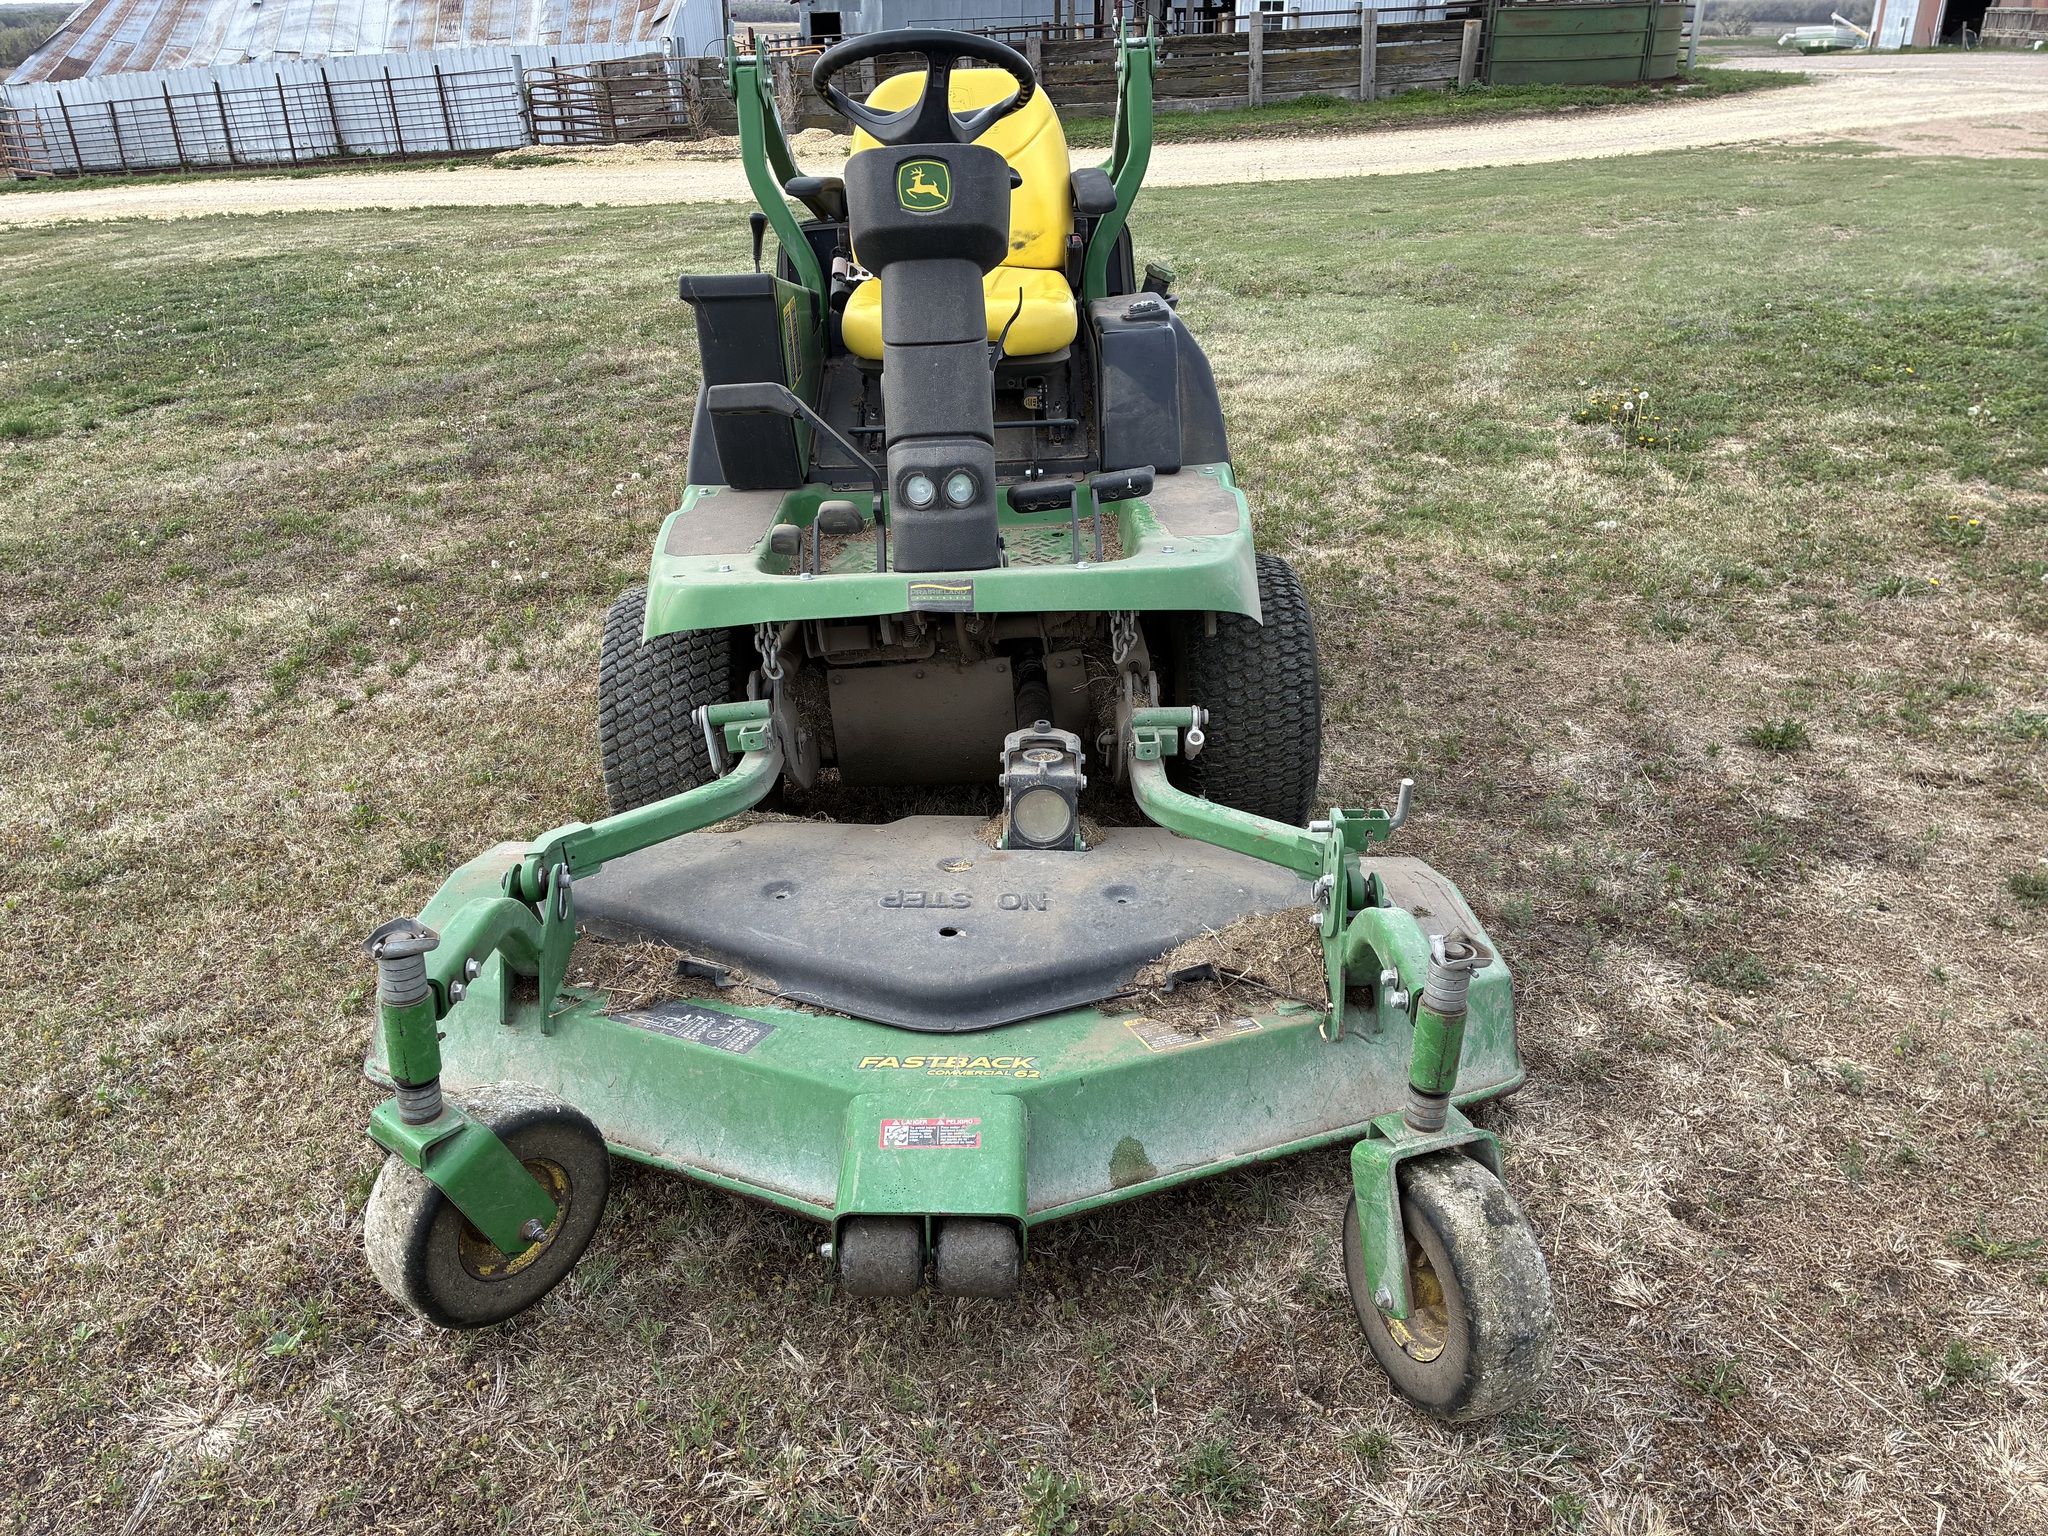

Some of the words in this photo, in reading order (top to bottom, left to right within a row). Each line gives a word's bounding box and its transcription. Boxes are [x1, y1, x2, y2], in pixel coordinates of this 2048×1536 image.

[879, 889, 973, 909] STEP
[997, 891, 1048, 911] NO
[858, 1056, 1036, 1069] FASTBACK
[1013, 1070, 1041, 1078] 62
